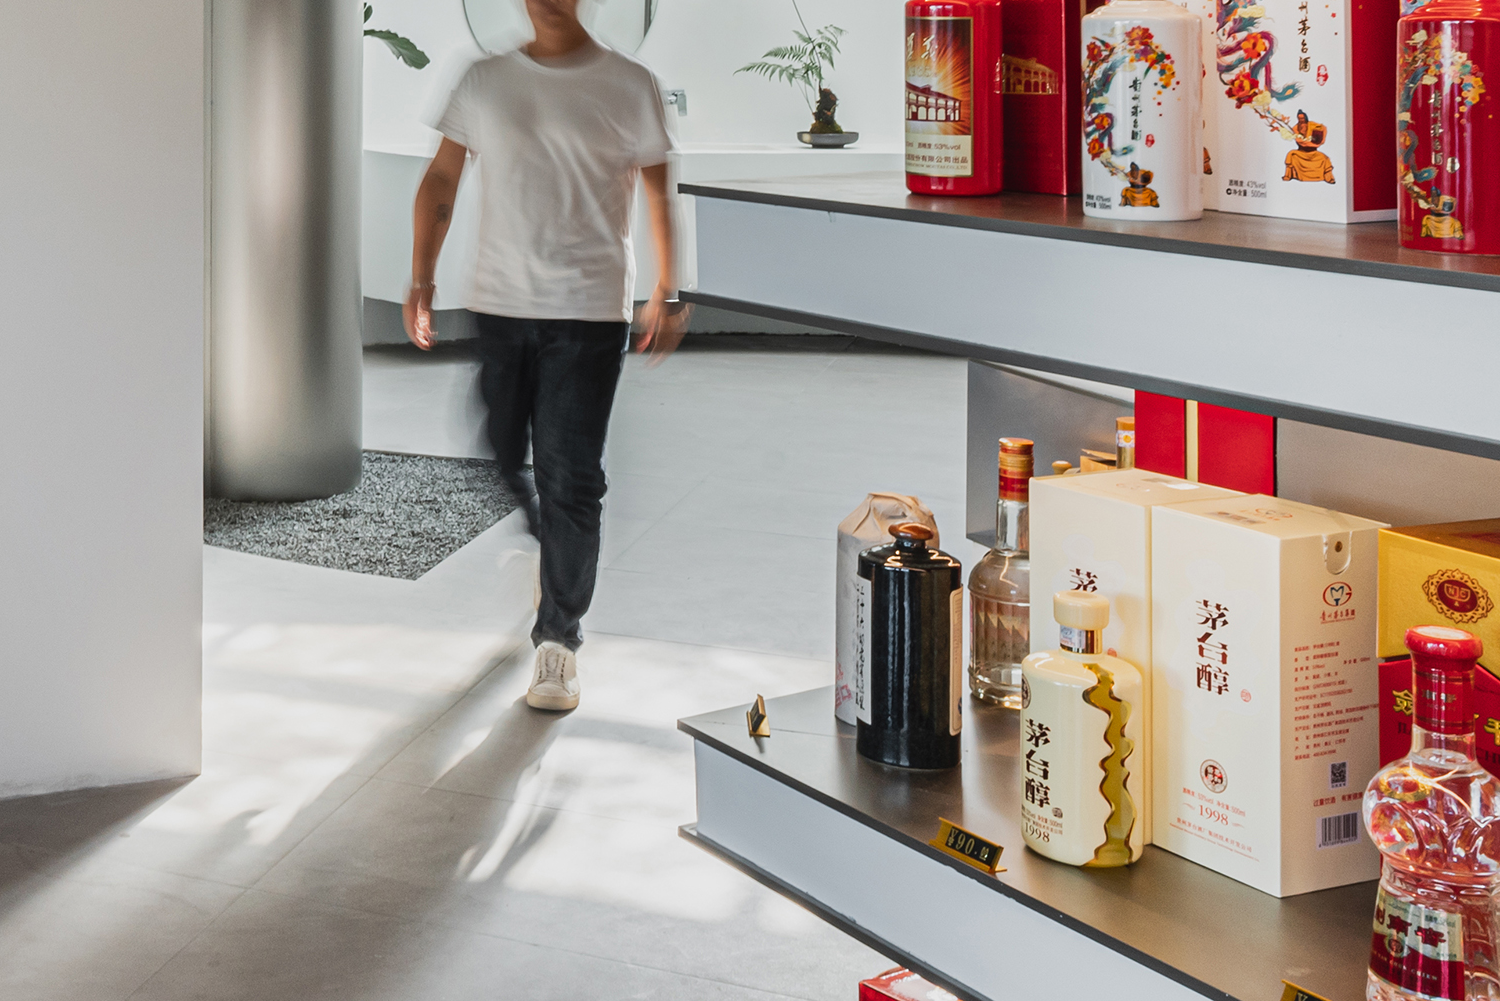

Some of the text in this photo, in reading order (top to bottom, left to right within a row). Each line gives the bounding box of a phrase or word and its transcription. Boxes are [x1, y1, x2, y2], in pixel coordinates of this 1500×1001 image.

[1195, 599, 1230, 696] 茅台醇
[1024, 718, 1052, 809] 茅台醇
[1025, 821, 1051, 843] 1998
[1198, 803, 1229, 827] 1998
